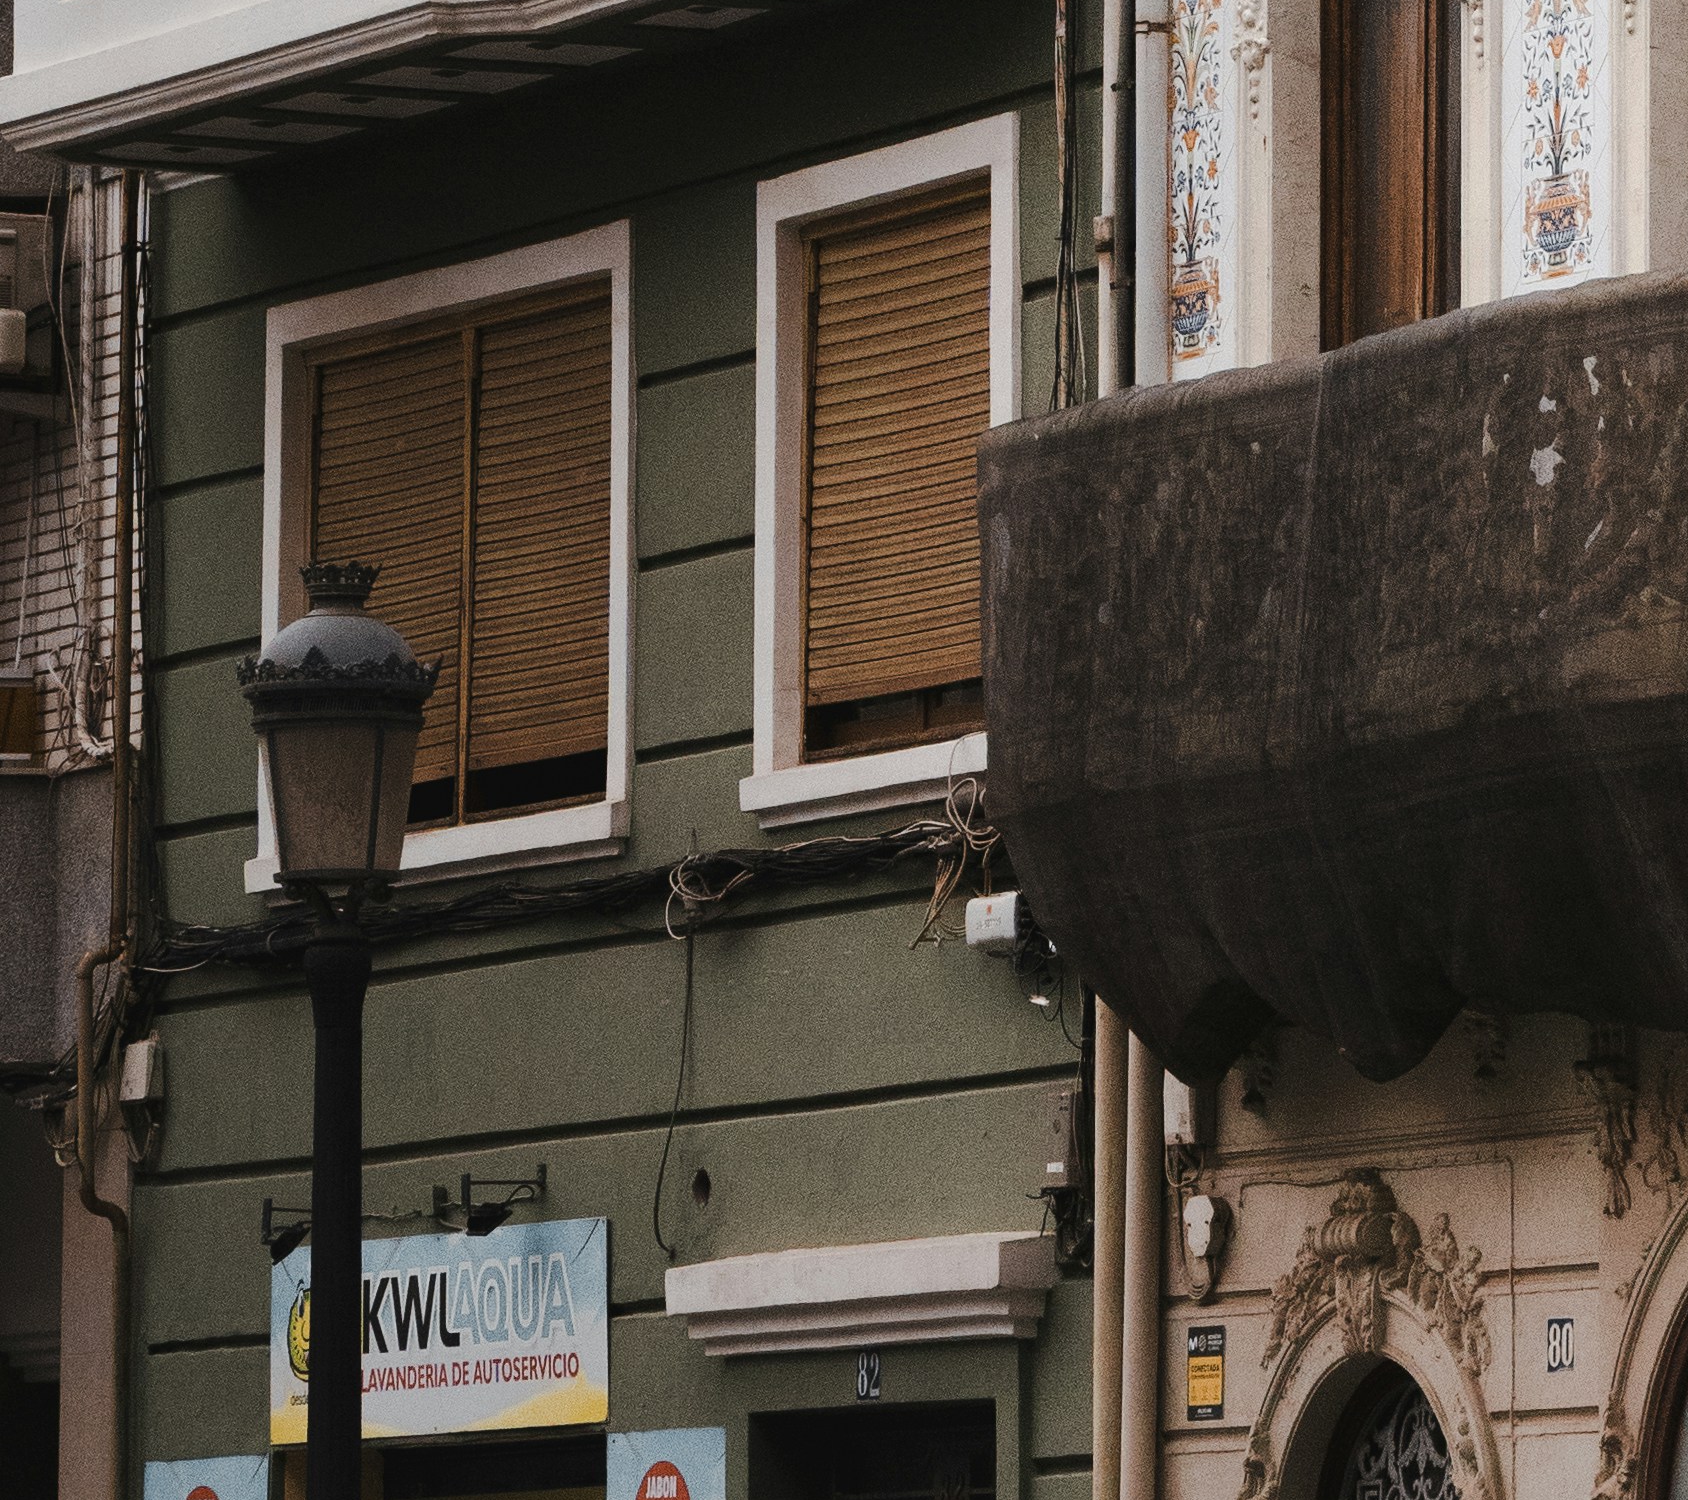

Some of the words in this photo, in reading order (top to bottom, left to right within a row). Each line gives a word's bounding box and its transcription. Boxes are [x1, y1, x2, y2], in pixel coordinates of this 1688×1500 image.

[1548, 1322, 1574, 1368] 80
[361, 1362, 449, 1393] LAVANDERIA
[451, 1361, 470, 1386] DE
[473, 1352, 580, 1385] AUTOSERVICIO
[858, 1353, 880, 1397] 82
[646, 1476, 677, 1499] JABON
